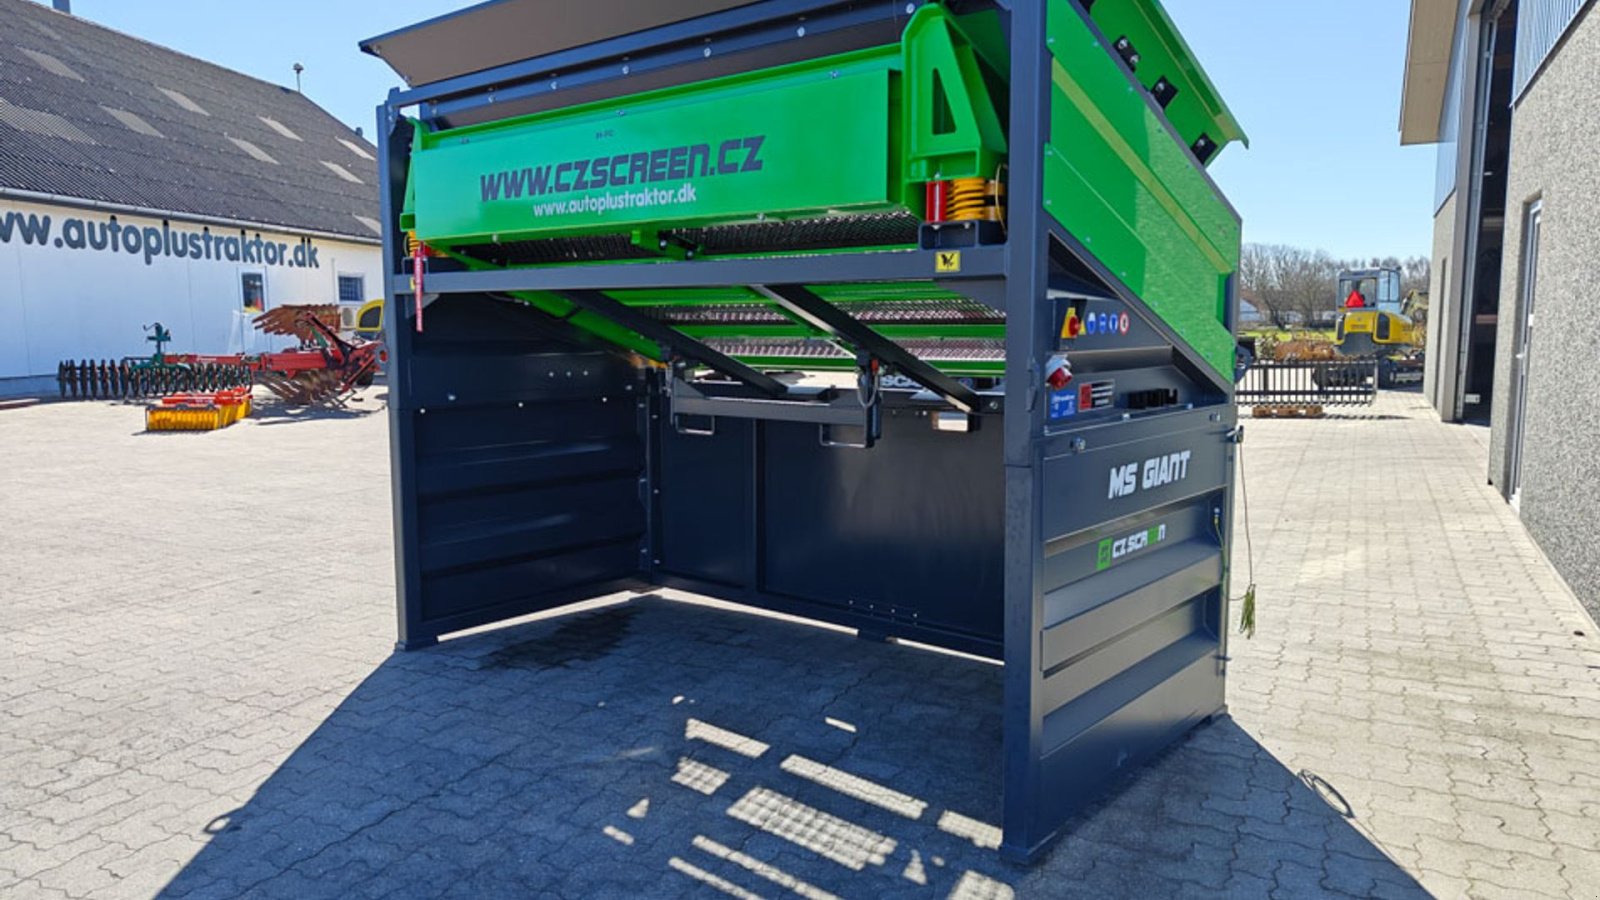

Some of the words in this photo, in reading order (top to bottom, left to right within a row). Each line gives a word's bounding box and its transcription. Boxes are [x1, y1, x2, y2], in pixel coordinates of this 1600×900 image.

[481, 136, 765, 202] WWW.CZSCREEN.CZ
[533, 183, 696, 216] www.autoplustraktor.dk
[1108, 462, 1138, 499] MS
[1142, 450, 1191, 489] GIANT
